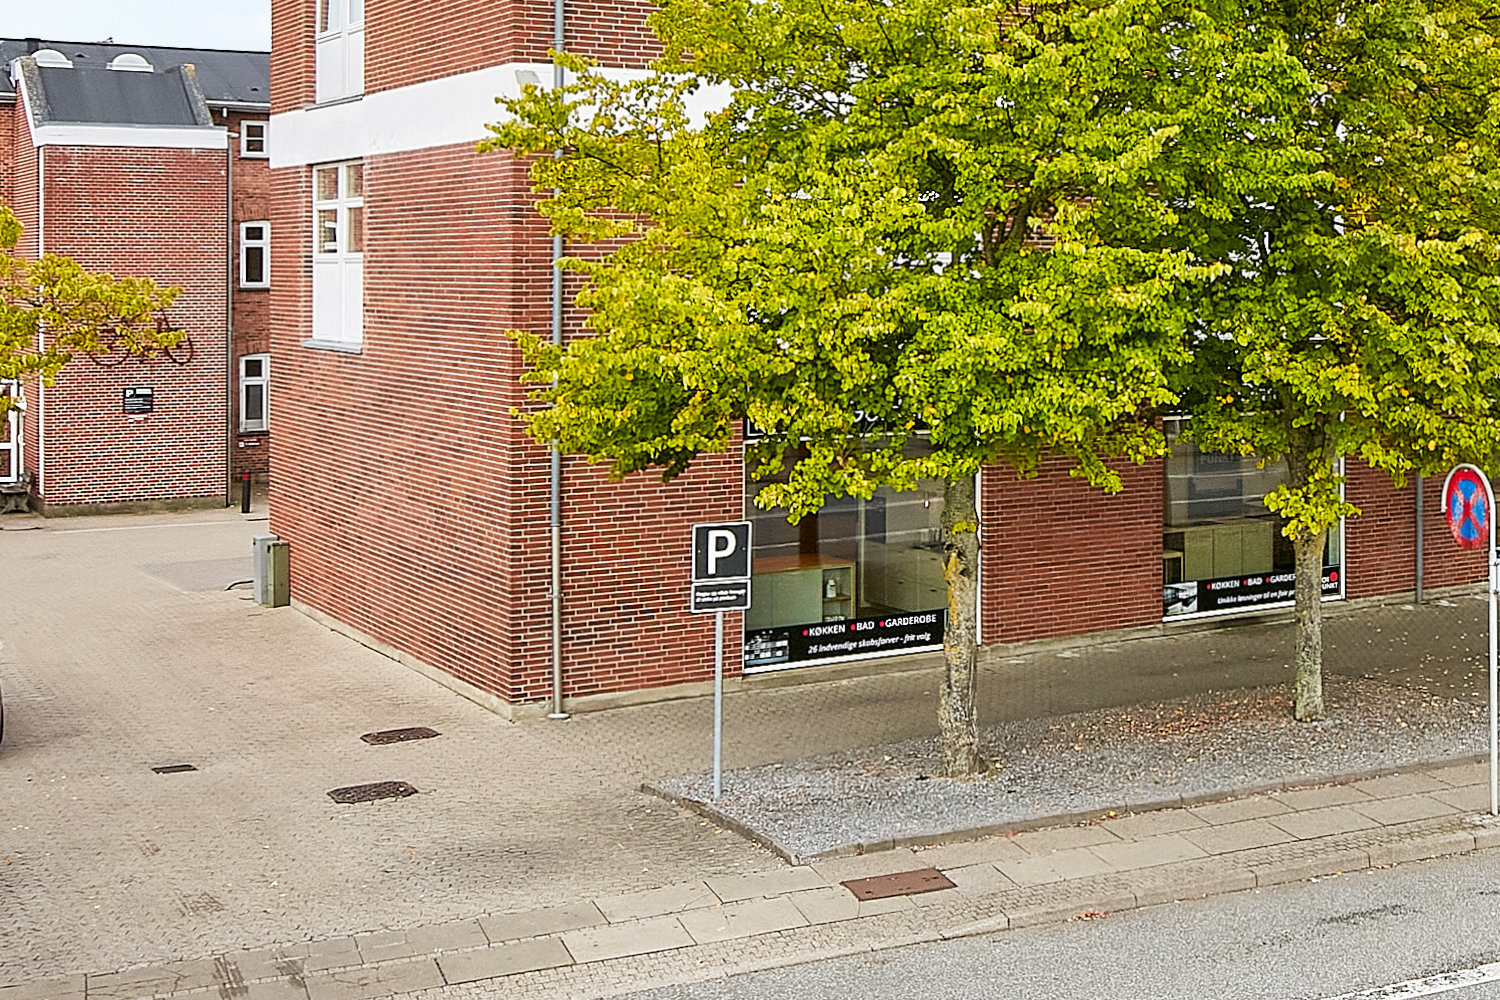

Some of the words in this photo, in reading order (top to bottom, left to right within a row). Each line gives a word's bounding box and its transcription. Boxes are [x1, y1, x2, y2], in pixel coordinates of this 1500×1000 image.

[708, 529, 737, 575] P
[1211, 580, 1240, 590] KØKKEN
[1247, 577, 1263, 586] BAD
[1270, 574, 1297, 583] GARDER
[1321, 582, 1338, 590] UNKT
[809, 624, 846, 637] KØKKEN
[856, 621, 875, 631] BAD
[885, 614, 937, 627] GARDEROBE
[808, 645, 818, 654] 26
